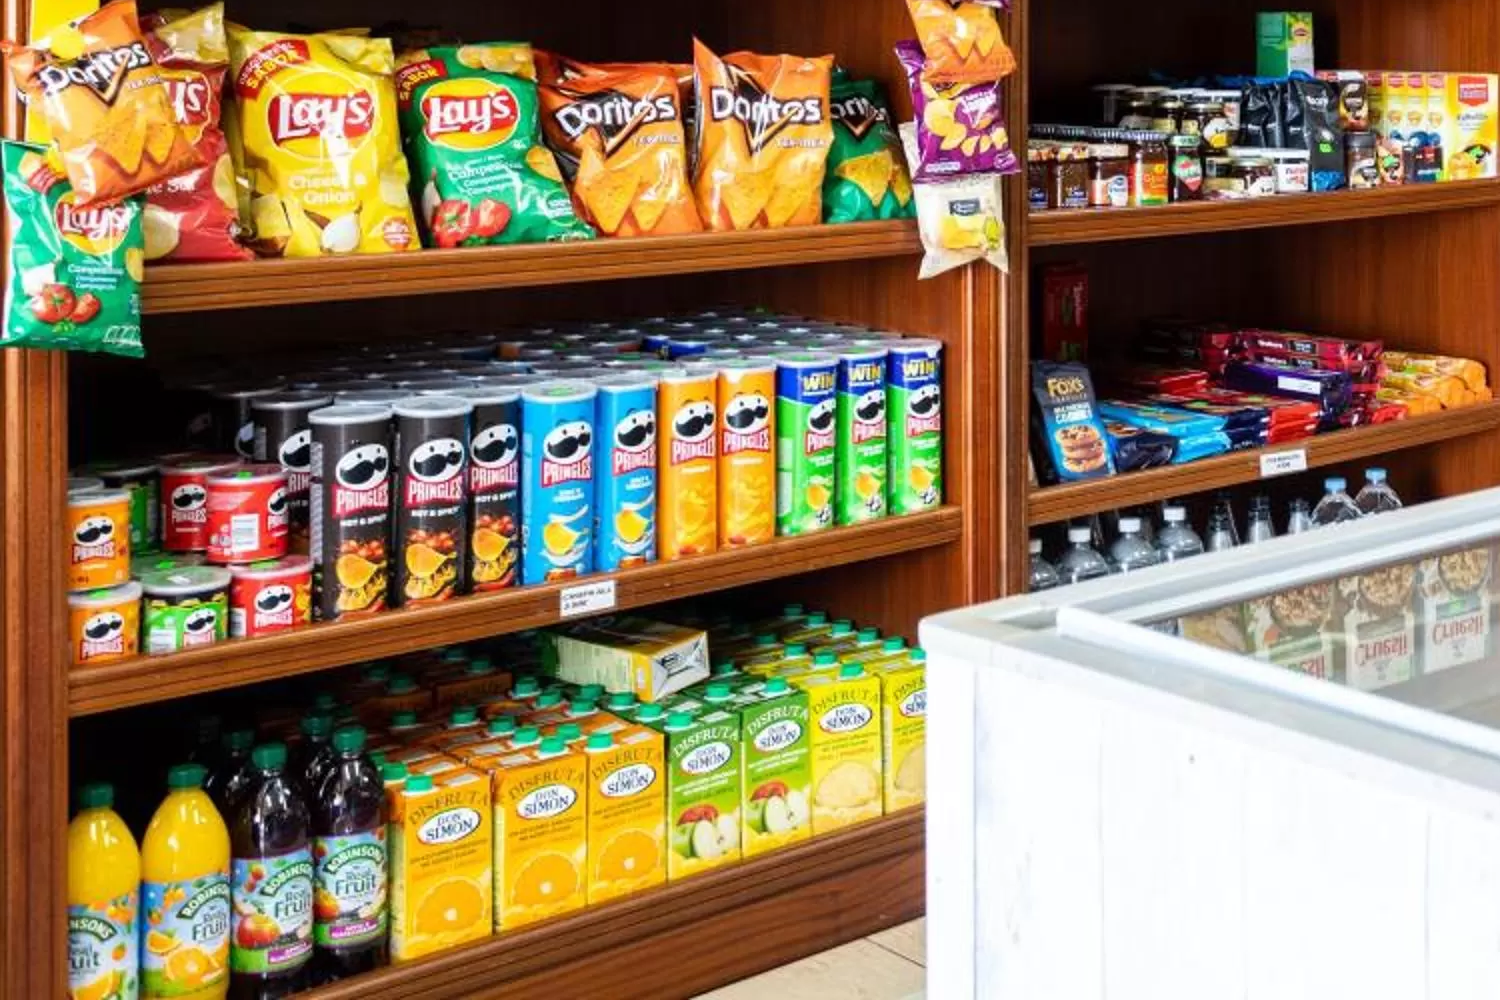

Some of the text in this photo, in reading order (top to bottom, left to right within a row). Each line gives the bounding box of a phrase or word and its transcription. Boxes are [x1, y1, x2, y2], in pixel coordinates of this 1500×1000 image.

[40, 40, 151, 96] Doritos
[278, 88, 371, 140] Lay's
[427, 88, 511, 134] Lay's
[556, 95, 676, 138] Doritos
[711, 88, 823, 124] Doritos
[336, 483, 390, 514] PRINGLES
[408, 475, 464, 504] PRINGLES
[746, 705, 808, 736] DISFRUTA
[673, 726, 740, 757] DISFRUTA
[758, 729, 797, 749] SIMON
[592, 748, 663, 781] DISFRUTA
[686, 751, 727, 772] SIMON
[508, 766, 585, 801] DISFRUTA
[607, 774, 650, 796] SIMON
[408, 789, 492, 826] DISFRUTA
[524, 795, 570, 816] SIMON
[425, 818, 474, 842] SIMON
[335, 874, 377, 896] Fruit
